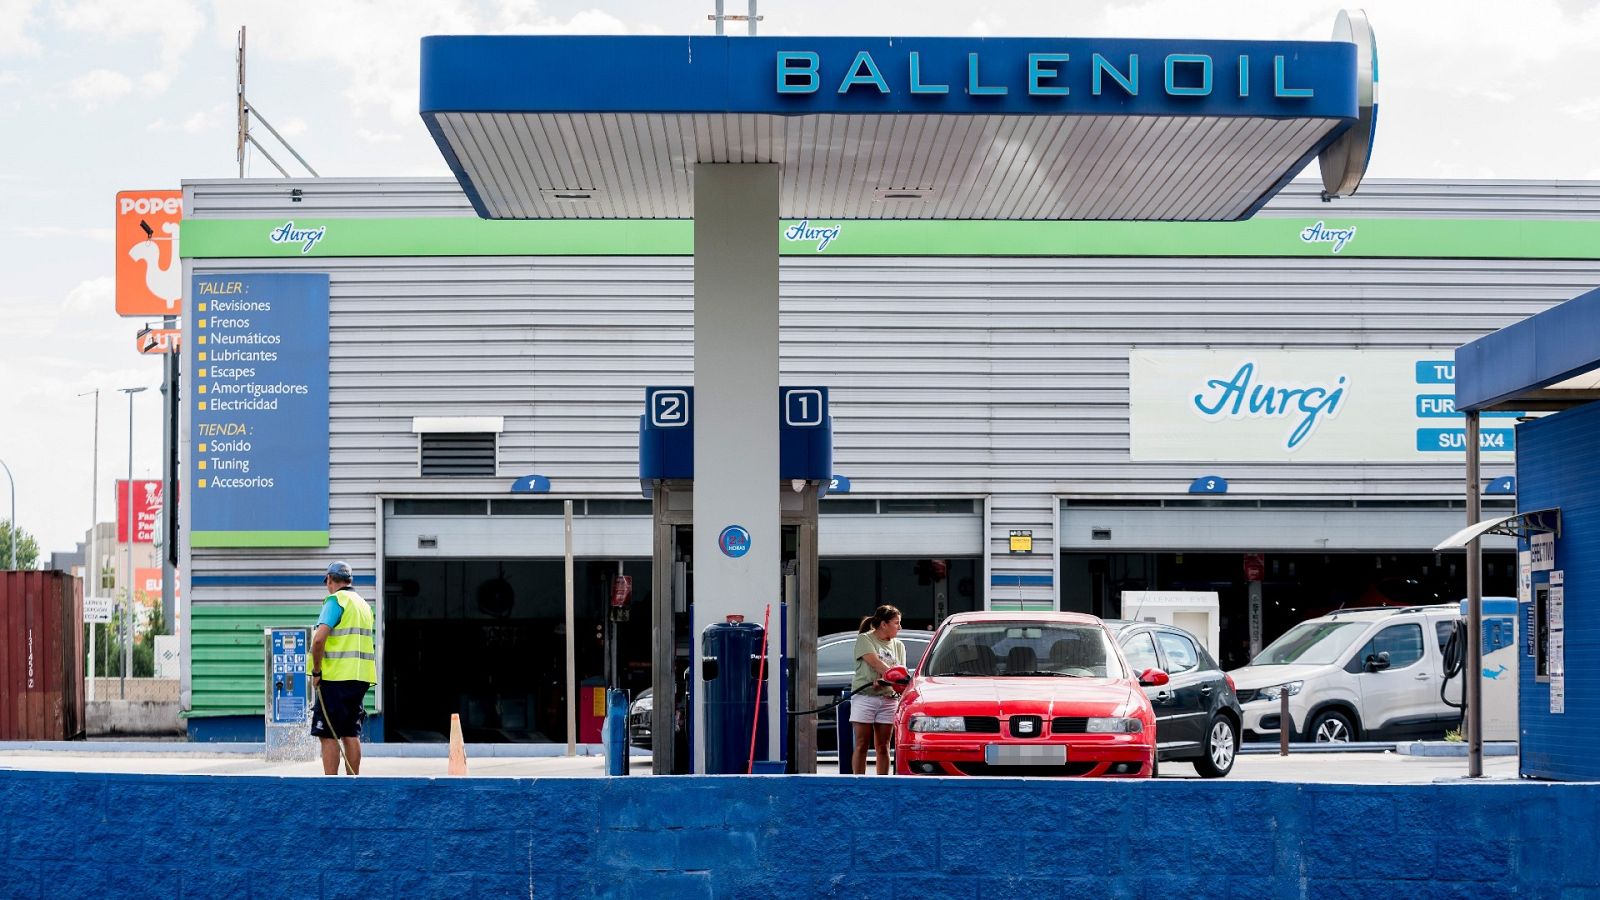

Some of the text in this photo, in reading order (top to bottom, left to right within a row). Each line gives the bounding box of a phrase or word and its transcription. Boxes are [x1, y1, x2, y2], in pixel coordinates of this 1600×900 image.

[776, 51, 1314, 97] BALLENOIL
[270, 223, 325, 252] Aurgi
[785, 220, 840, 251] Aurgi
[1301, 222, 1355, 252] Aurgi
[210, 300, 271, 312] Revisiones
[210, 316, 250, 329] Frenos
[143, 333, 181, 351] AUT
[210, 331, 281, 345] Neumáticos
[211, 349, 277, 362] Lubricantes
[211, 366, 256, 381] Escapes
[1433, 365, 1456, 380] TU
[211, 382, 308, 398] Amortiguadores
[210, 398, 278, 411] Electricidad
[661, 397, 681, 419] 2
[798, 396, 808, 419] 1
[1195, 362, 1345, 448] Aurgi
[1421, 398, 1455, 413] FUR
[199, 423, 247, 436] TIENDA
[211, 440, 251, 452] Sonido
[211, 457, 250, 473] Tuning
[211, 475, 274, 488] Accesorios
[829, 479, 838, 488] 2
[1206, 480, 1216, 490] 3
[1503, 481, 1512, 490] 4
